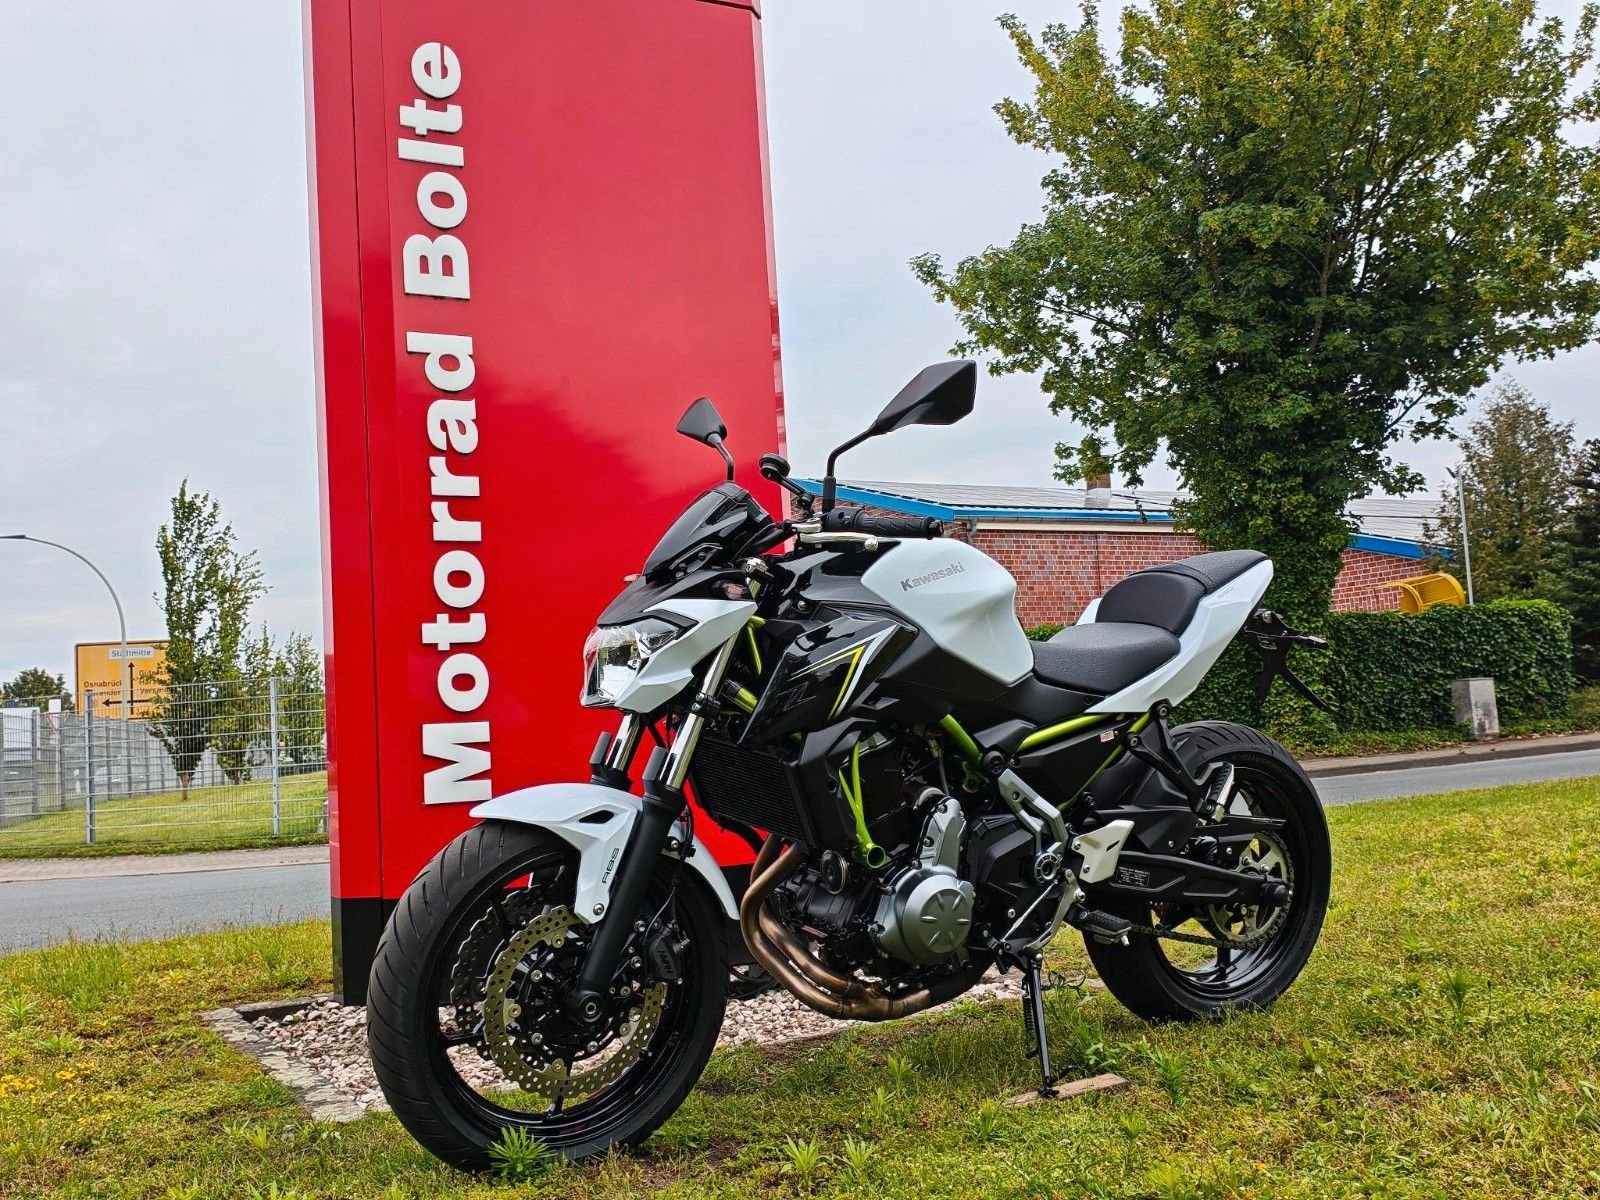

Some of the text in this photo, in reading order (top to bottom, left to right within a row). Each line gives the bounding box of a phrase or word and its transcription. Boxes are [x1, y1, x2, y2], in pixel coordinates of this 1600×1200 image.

[398, 42, 492, 804] Motorrad Bolte
[900, 562, 965, 591] Kawasaki
[602, 848, 619, 883] ABS
